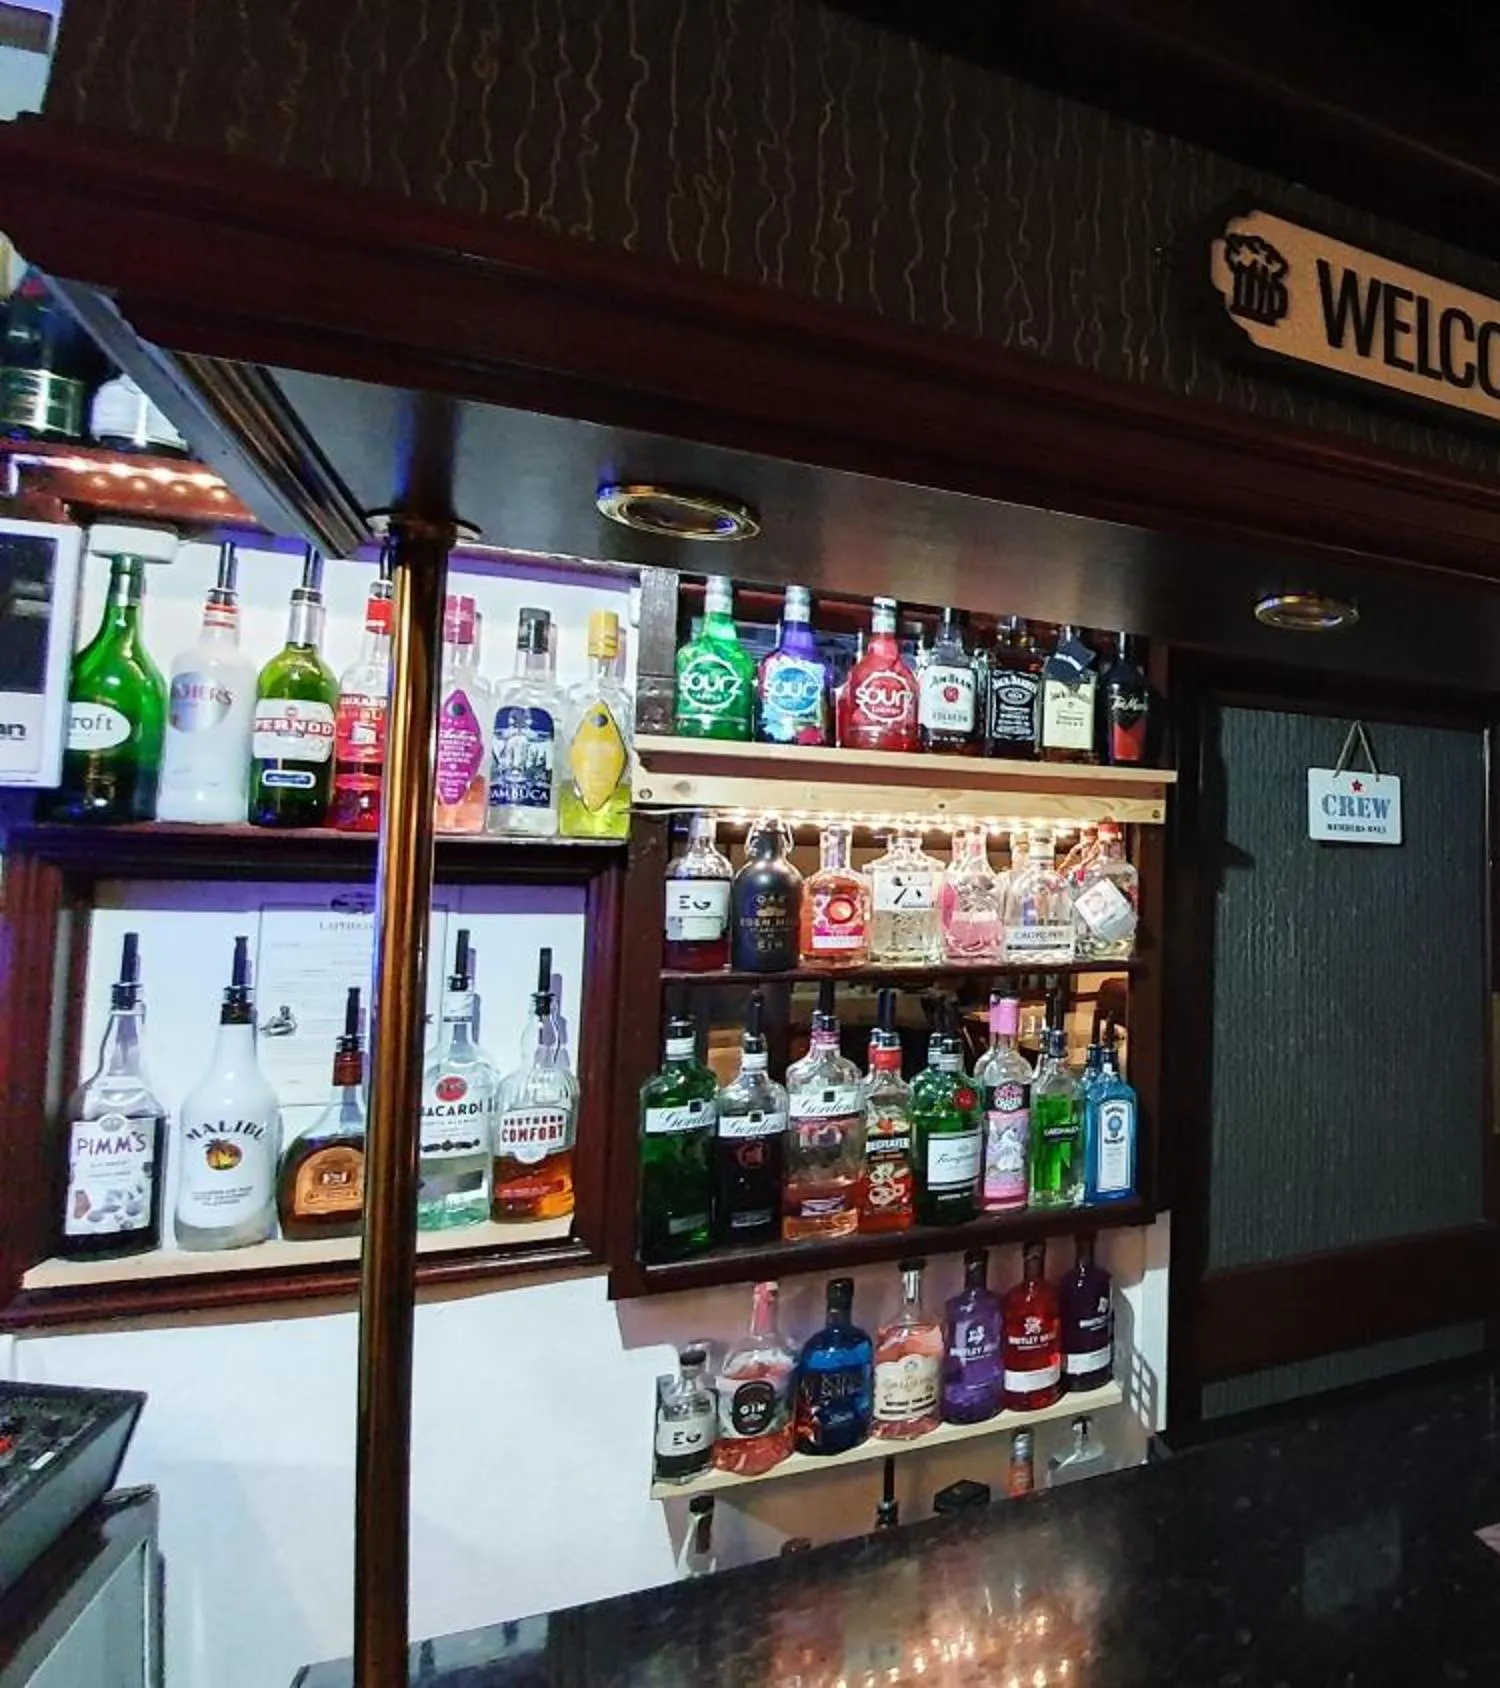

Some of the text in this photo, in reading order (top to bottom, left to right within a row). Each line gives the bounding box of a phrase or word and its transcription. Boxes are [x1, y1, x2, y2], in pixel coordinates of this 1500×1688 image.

[69, 713, 112, 732] roft
[490, 787, 549, 803] AMBUCA
[1321, 793, 1391, 819] CREW
[421, 1103, 483, 1118] ACARDI
[184, 1120, 266, 1142] MALIBU
[501, 1125, 564, 1143] COMFORT
[76, 1131, 147, 1157] PIMM'S
